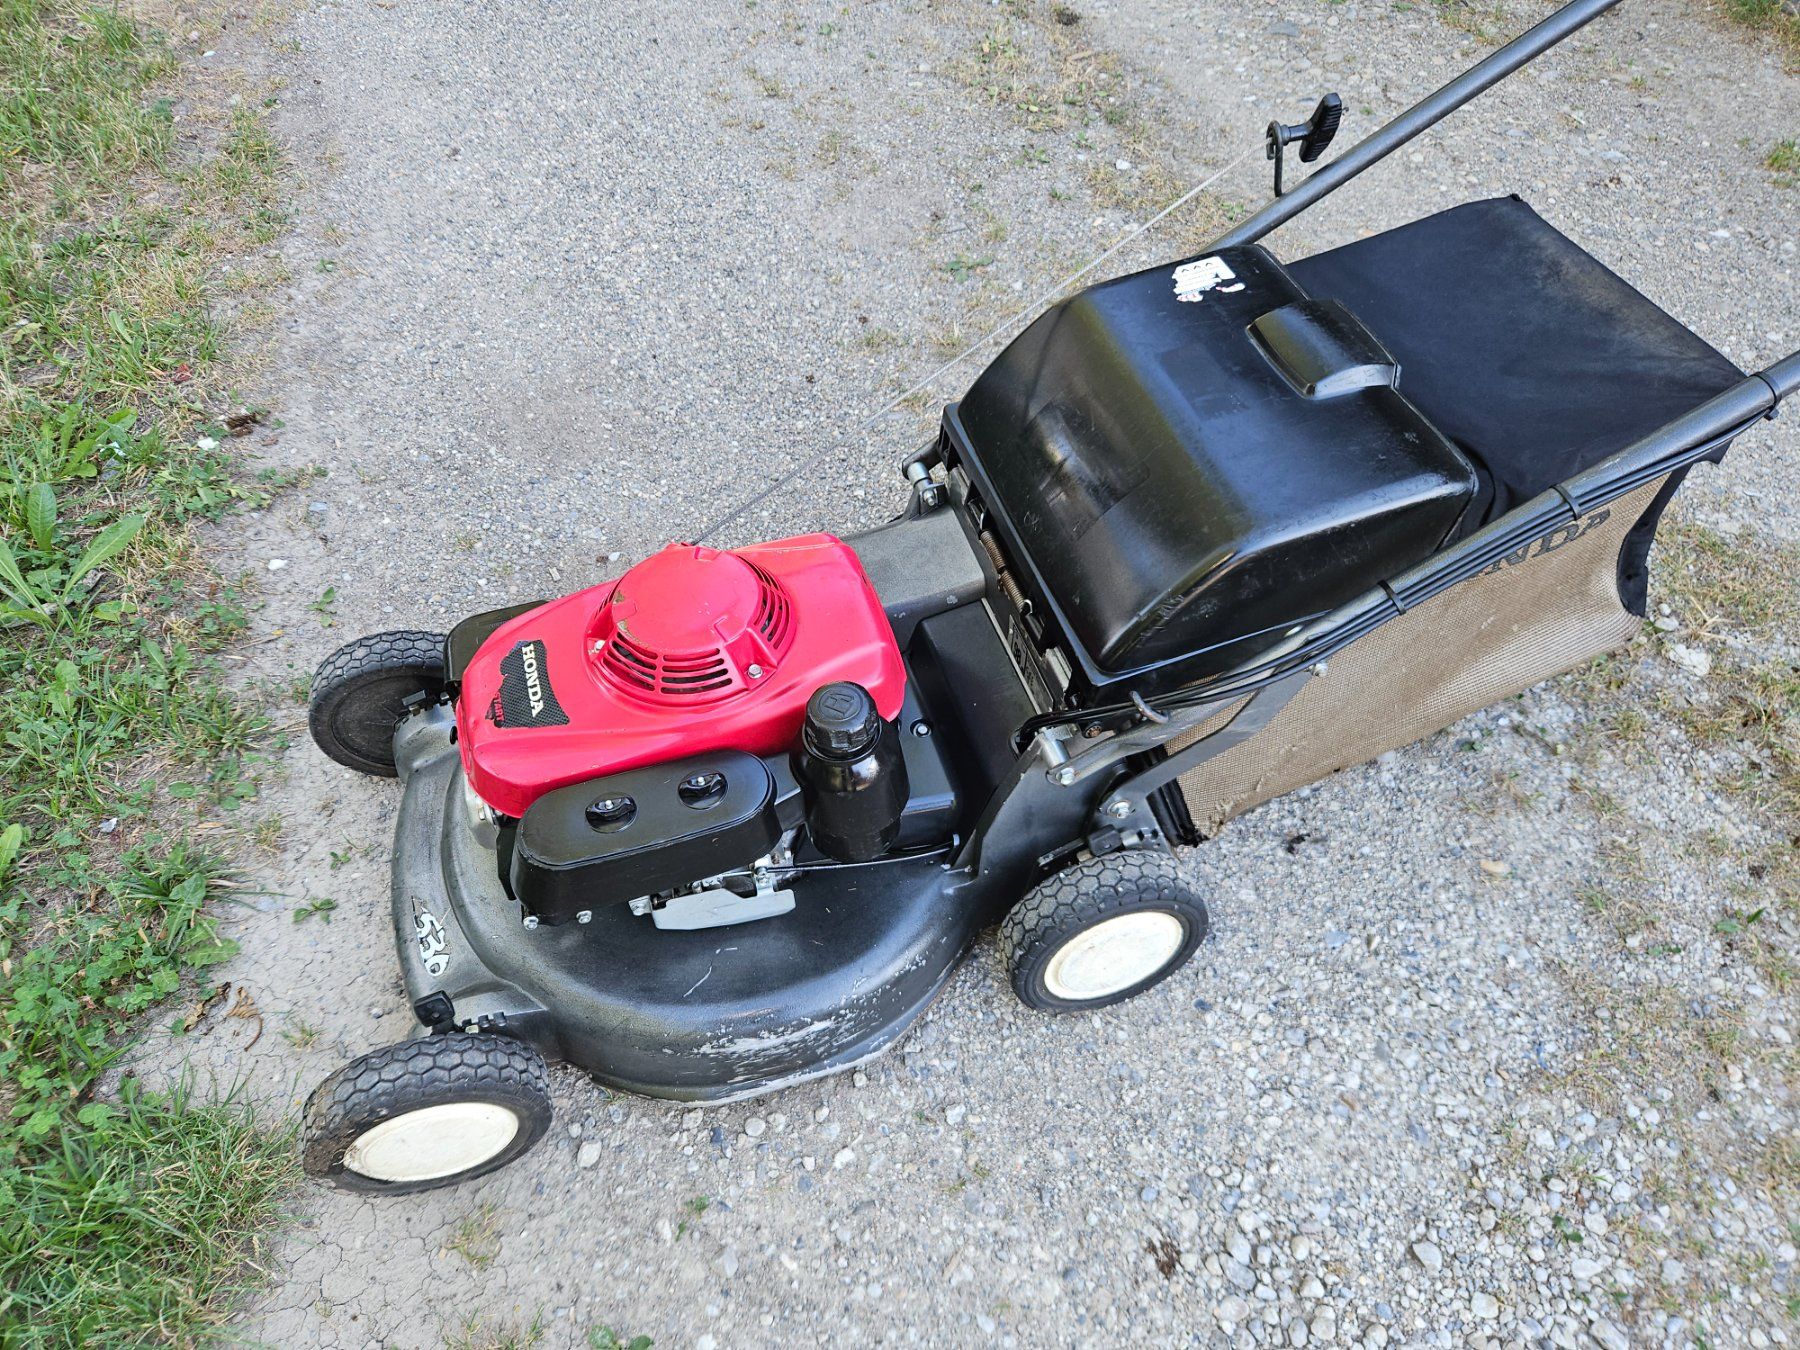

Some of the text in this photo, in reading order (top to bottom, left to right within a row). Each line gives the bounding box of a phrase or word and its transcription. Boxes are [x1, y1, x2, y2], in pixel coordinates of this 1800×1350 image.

[1476, 509, 1611, 576] NDA
[521, 643, 544, 718] HONDA
[412, 908, 450, 977] 536
